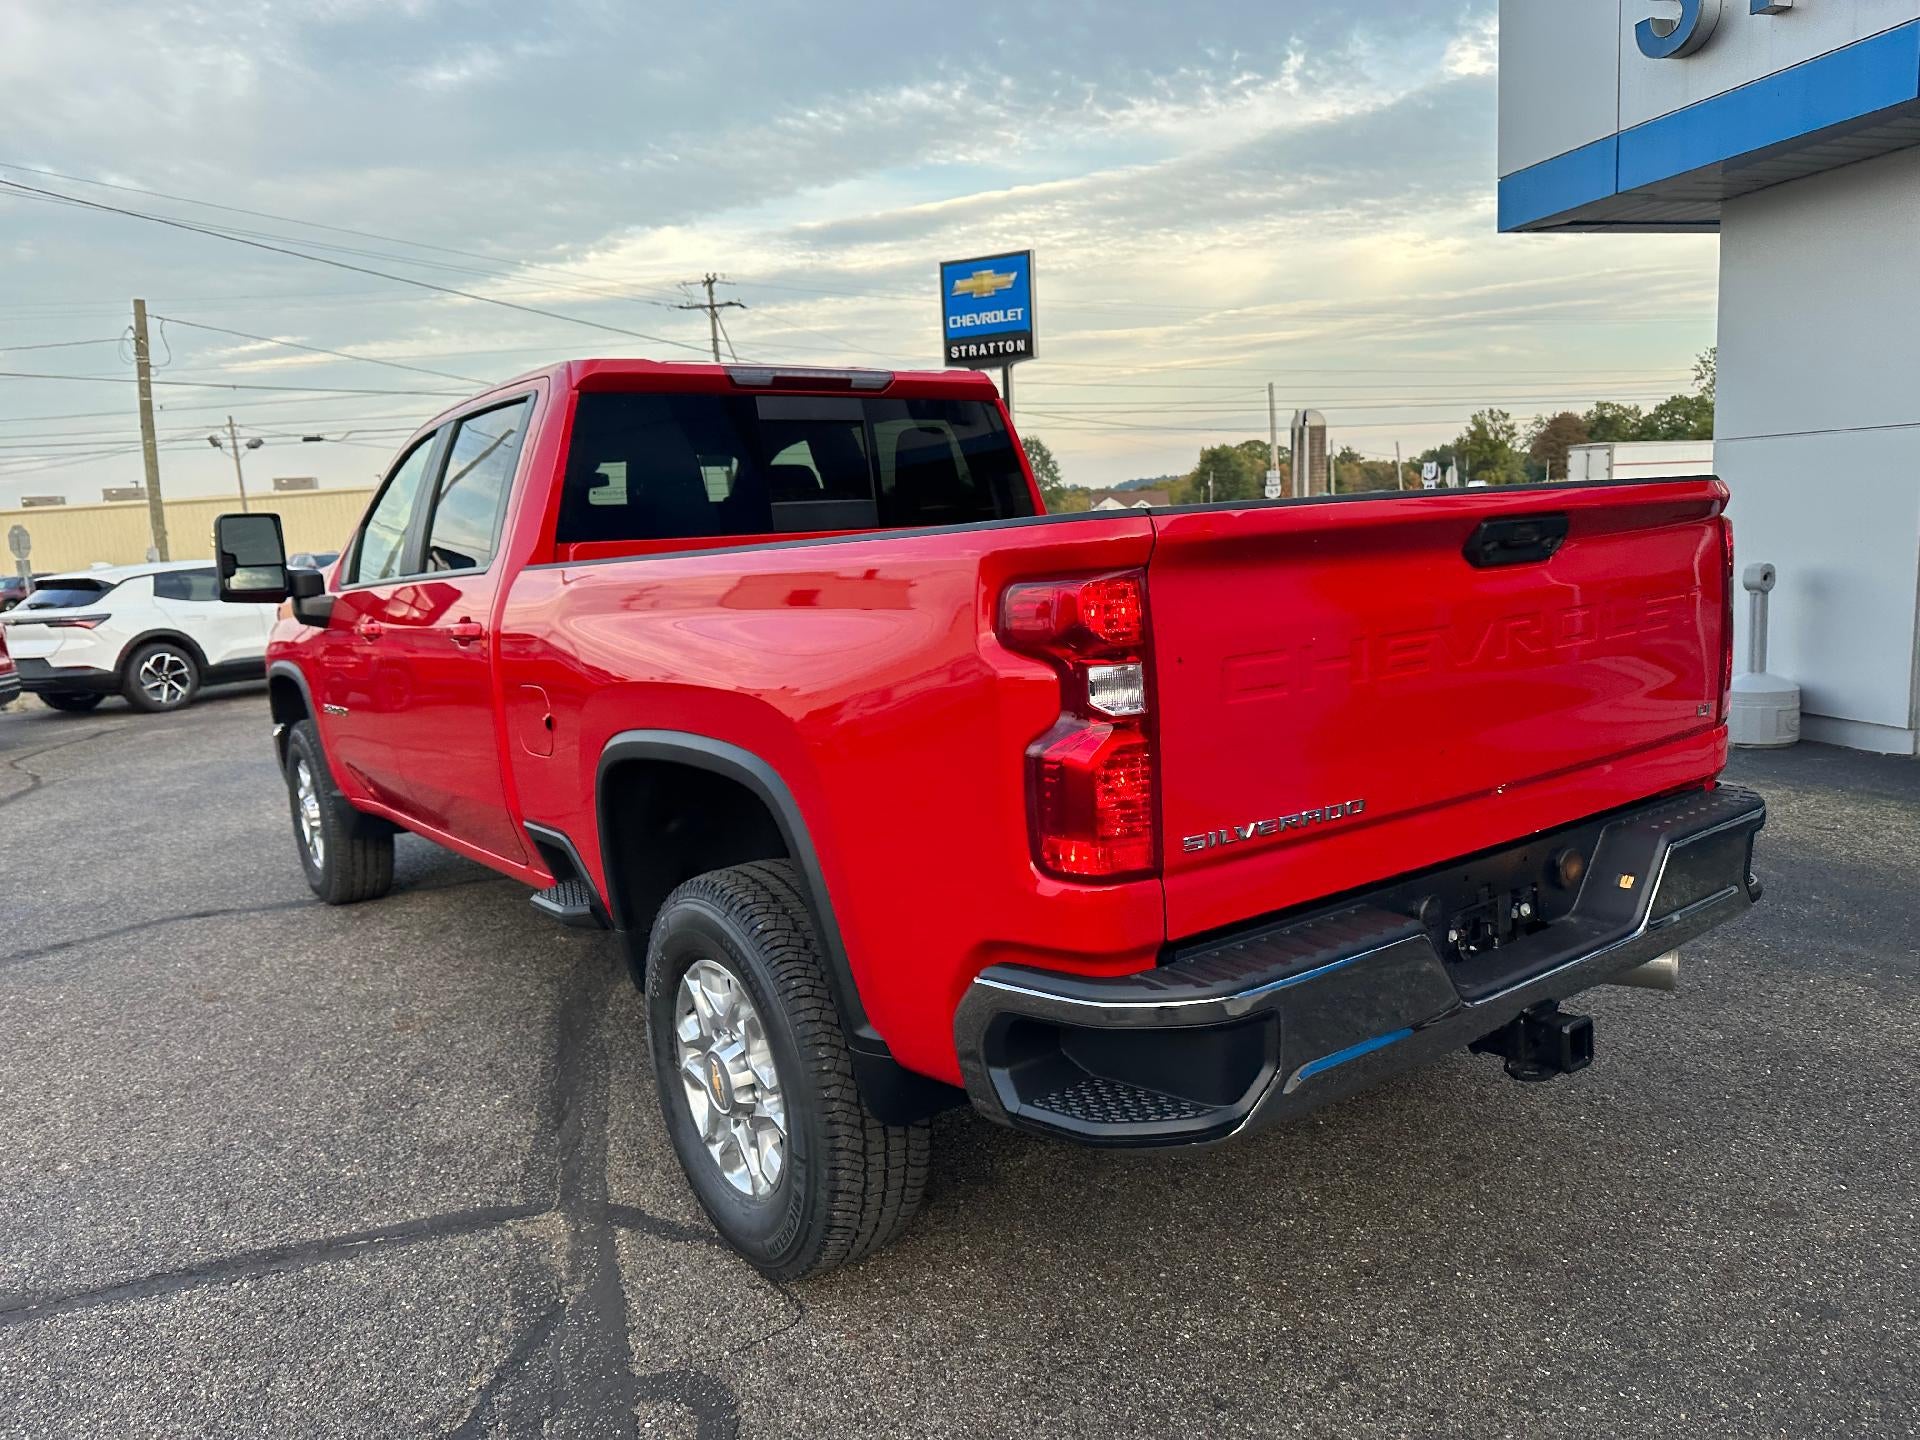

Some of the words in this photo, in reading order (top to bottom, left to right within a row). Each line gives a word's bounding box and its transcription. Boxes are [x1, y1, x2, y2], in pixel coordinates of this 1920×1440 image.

[948, 307, 1024, 329] CHEVROLET
[950, 339, 1026, 359] STRATTON
[1220, 586, 1700, 704] CHEVROLET
[1182, 798, 1367, 852] SILVERADO
